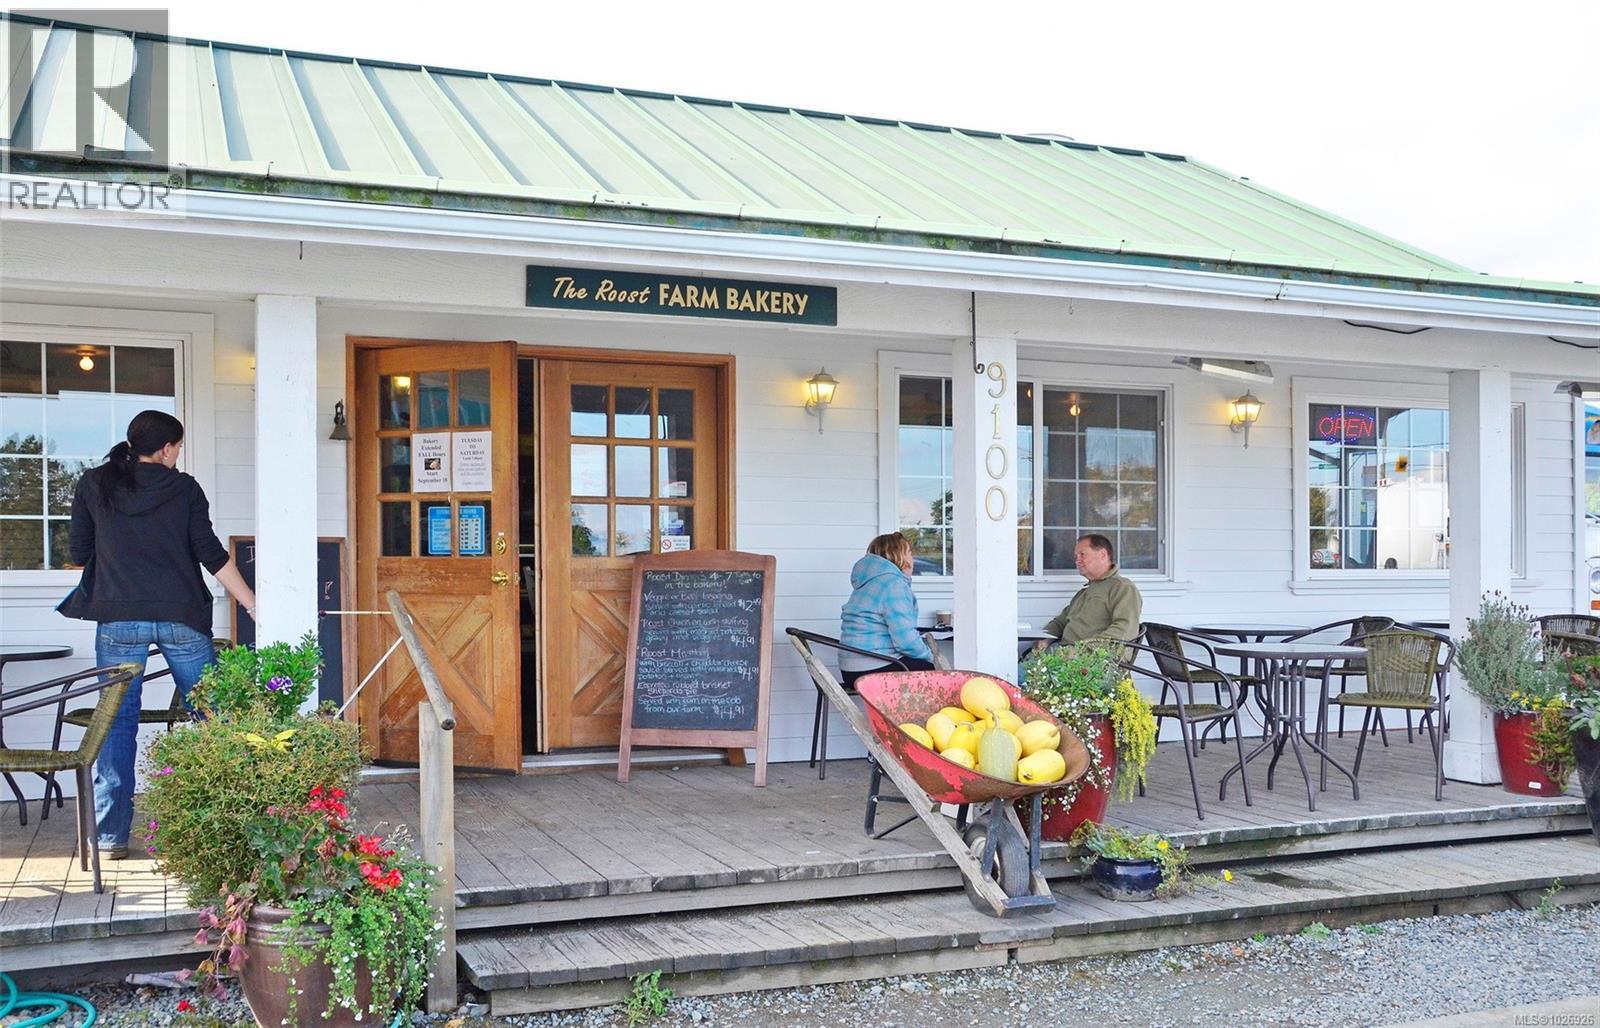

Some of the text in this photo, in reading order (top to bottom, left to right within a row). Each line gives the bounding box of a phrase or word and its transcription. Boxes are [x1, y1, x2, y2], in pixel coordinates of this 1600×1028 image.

[553, 277, 808, 316] The Roost FARM BAKERY
[985, 361, 1010, 521] 9100
[1319, 416, 1375, 438] OPEN
